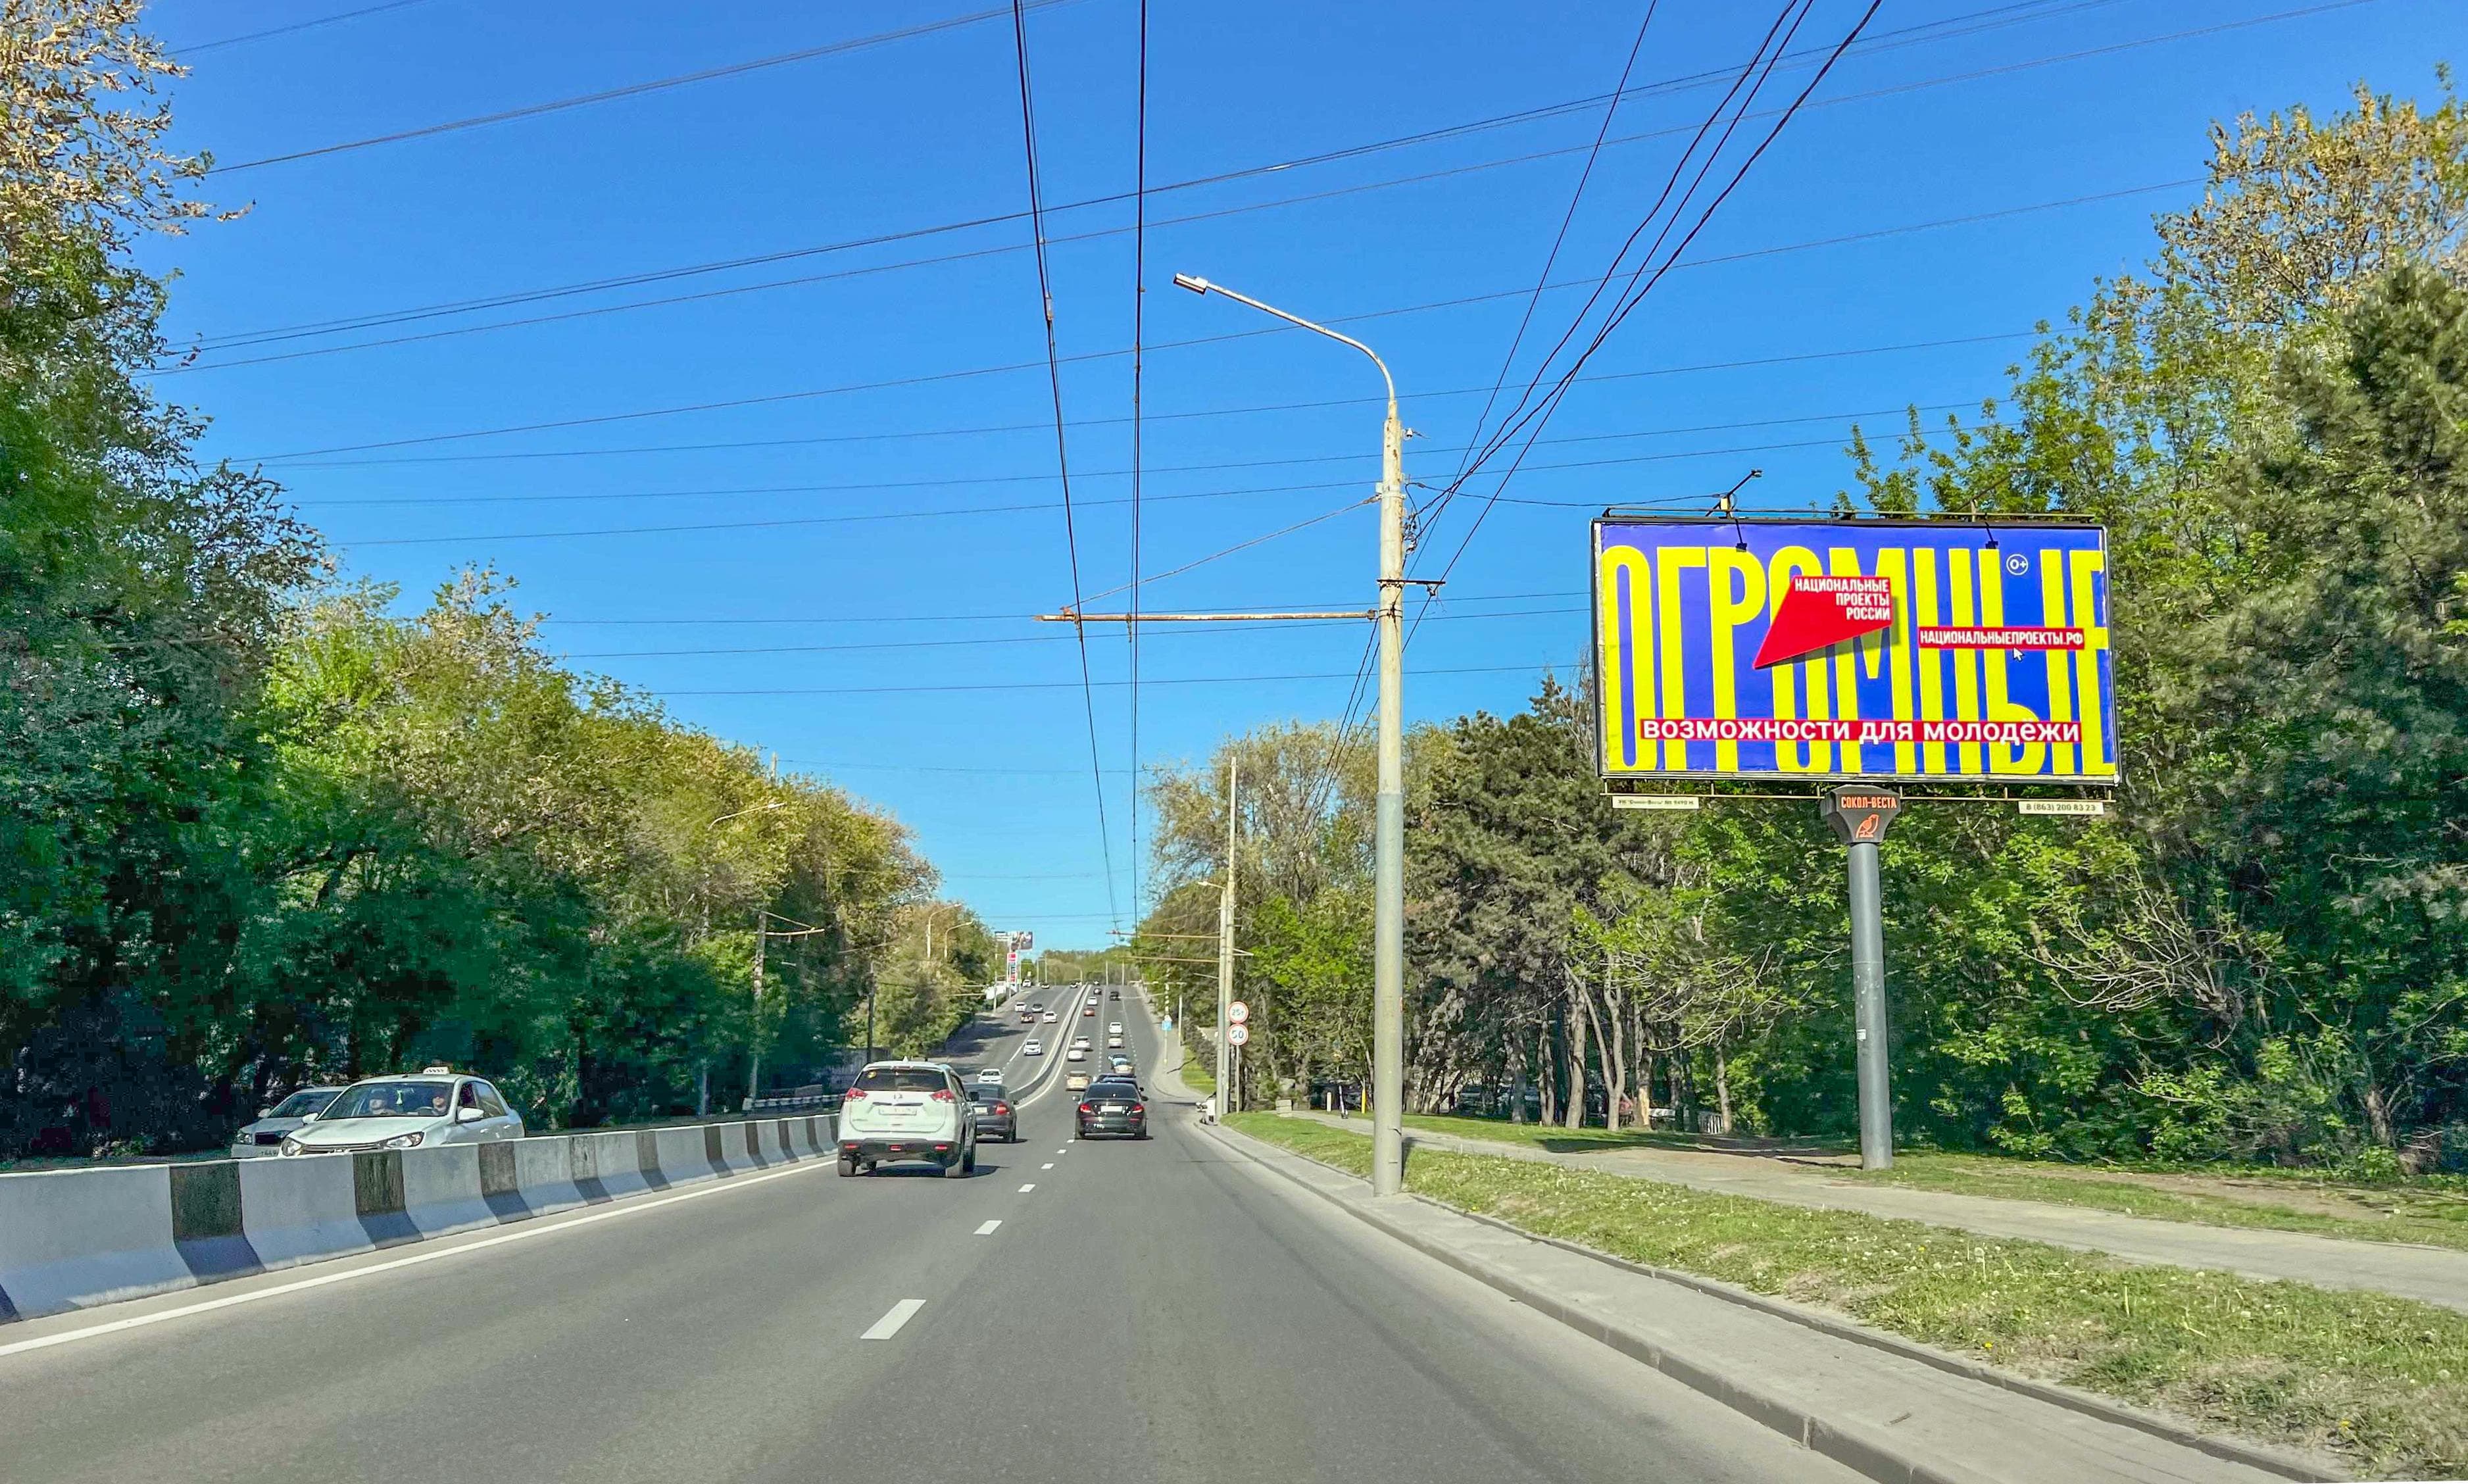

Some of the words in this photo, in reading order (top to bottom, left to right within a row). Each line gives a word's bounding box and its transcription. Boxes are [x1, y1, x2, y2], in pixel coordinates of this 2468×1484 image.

[2010, 559, 2027, 570] 0+
[1794, 578, 1889, 593] НАЦИОНАЛЬНЫЕ
[1835, 592, 1890, 606] ПРОЕКТЫ
[1846, 606, 1891, 620] РОССИИ
[1919, 630, 2084, 646] НАЦИОНАЛЬНЫЕПРОЕКТЫ.РФ
[1601, 545, 2117, 776] ОГРОМНЫЕ
[1642, 720, 1850, 740] возможности
[1858, 722, 1913, 745] для
[1925, 719, 2079, 745] молодёжи
[1840, 796, 1898, 809] СОКОЛ-ВЕСТА
[2033, 803, 2055, 812] (863)
[1231, 1030, 1244, 1039] 50
